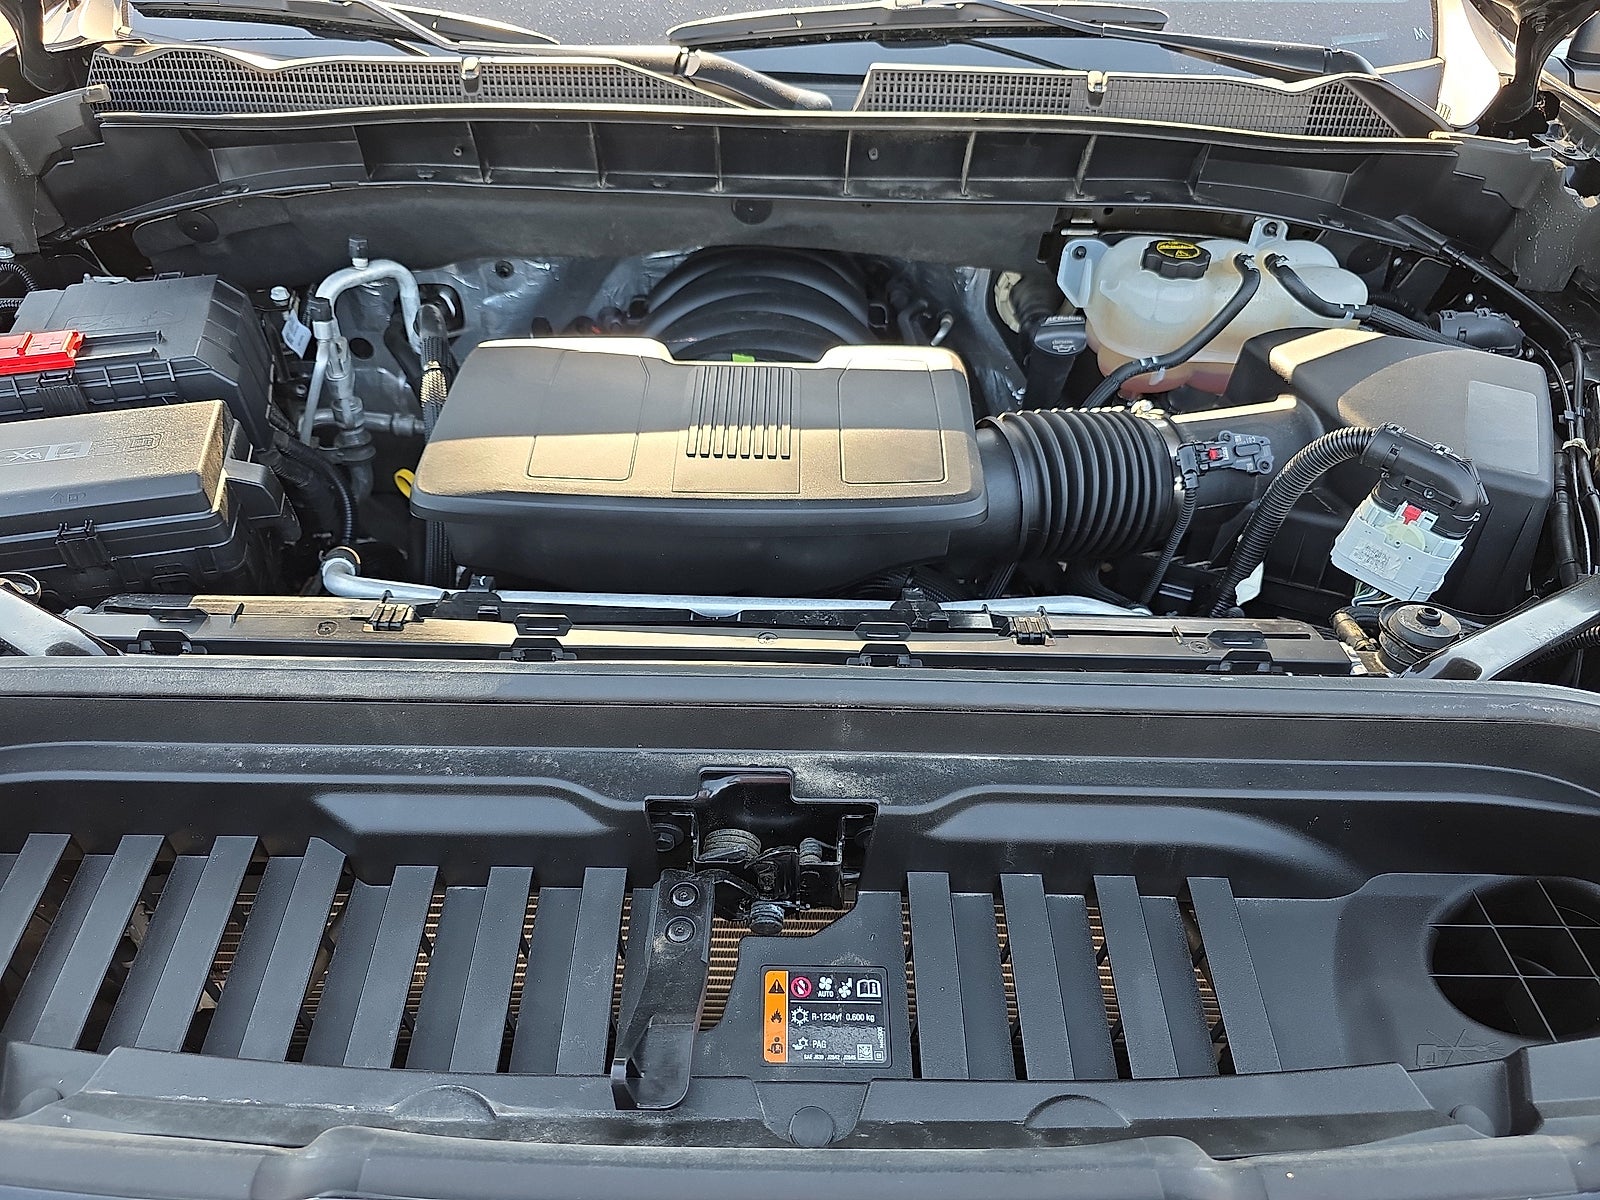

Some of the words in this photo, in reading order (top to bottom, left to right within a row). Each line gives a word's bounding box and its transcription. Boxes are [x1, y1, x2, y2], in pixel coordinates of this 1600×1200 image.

[811, 1013, 842, 1022] R-1234yf
[846, 1013, 865, 1021] 0.600
[866, 1013, 875, 1022] kg
[812, 1040, 827, 1048] PAG
